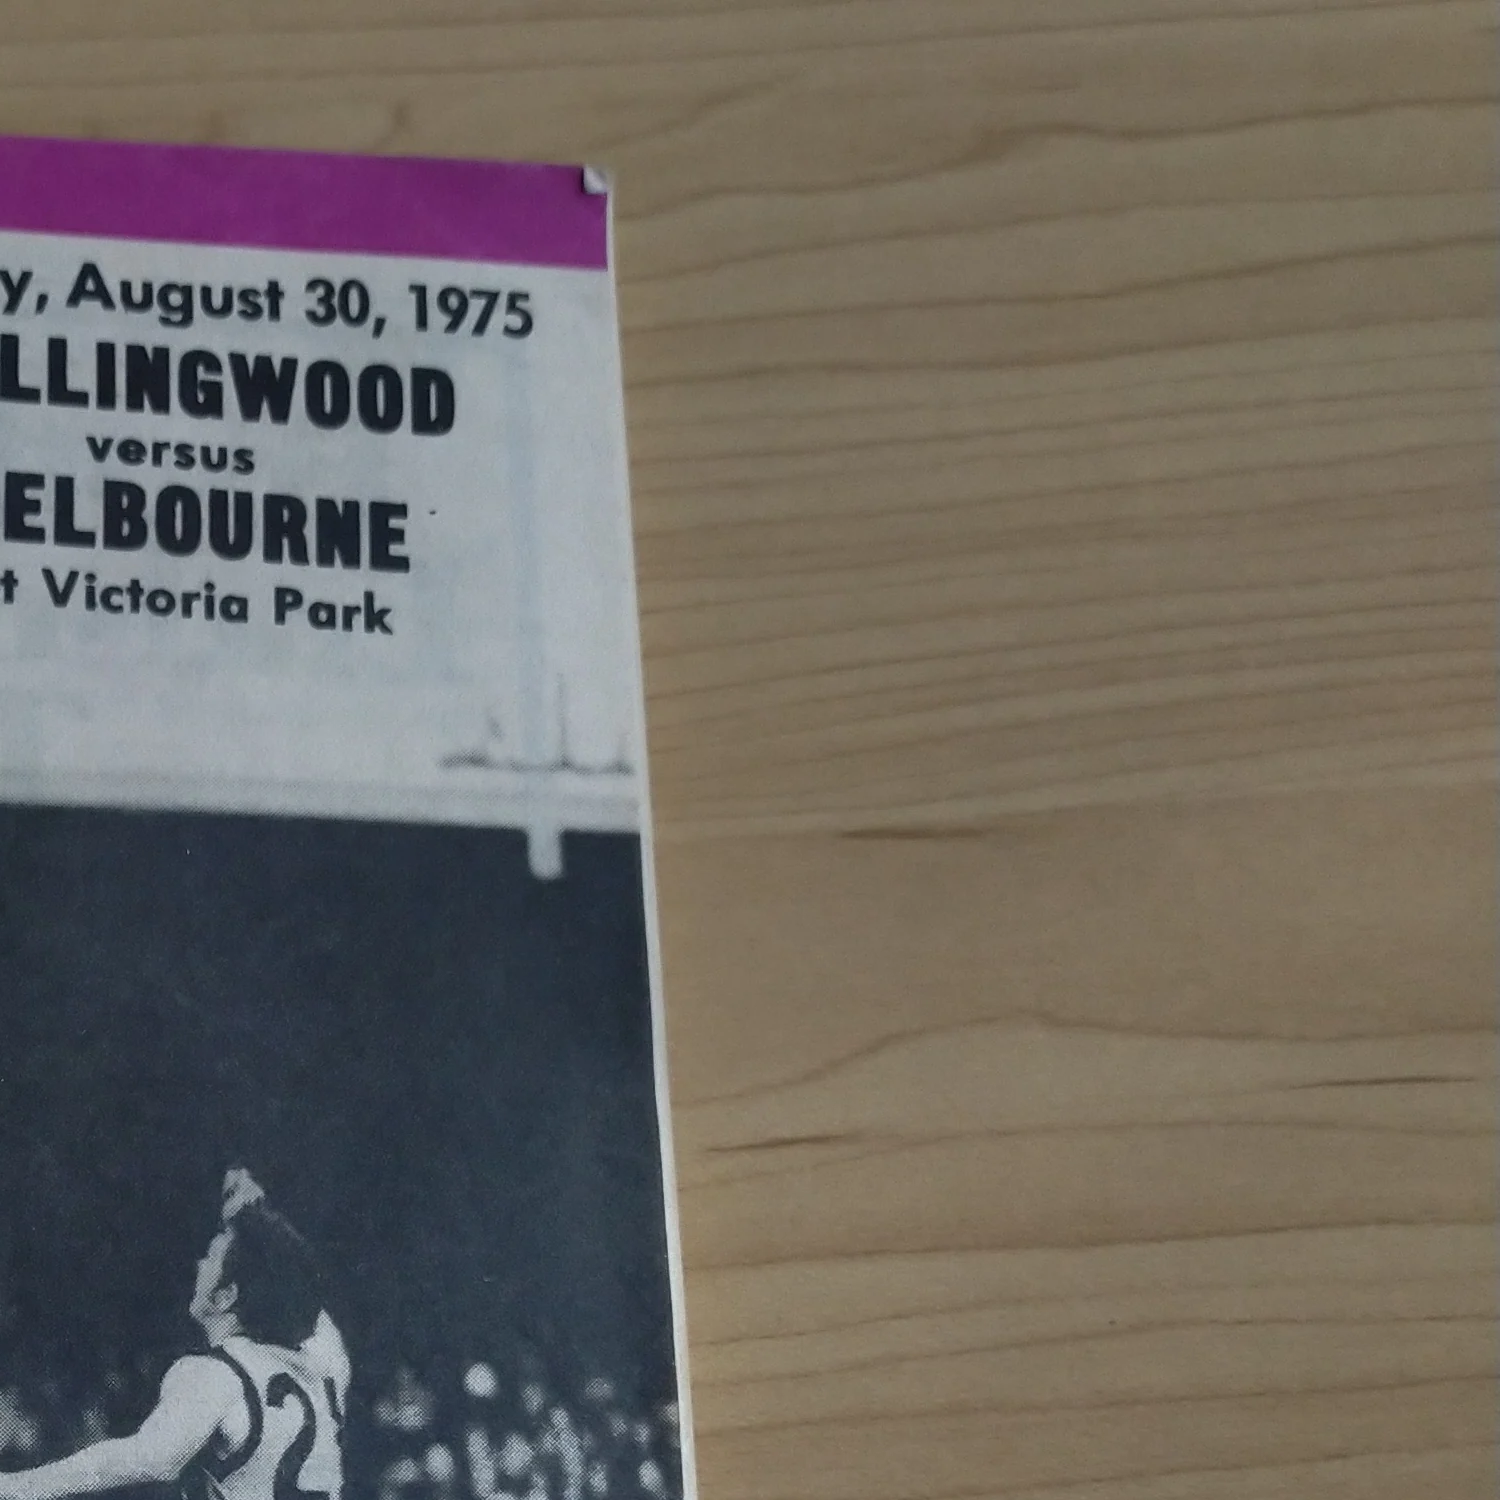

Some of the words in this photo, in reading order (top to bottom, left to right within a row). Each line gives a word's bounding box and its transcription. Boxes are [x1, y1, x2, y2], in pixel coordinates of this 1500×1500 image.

[67, 262, 284, 328] August
[306, 278, 386, 338] 30,
[409, 284, 533, 338] 1975
[86, 436, 254, 475] versus
[42, 568, 248, 623] Victoria
[275, 587, 392, 634] Park
